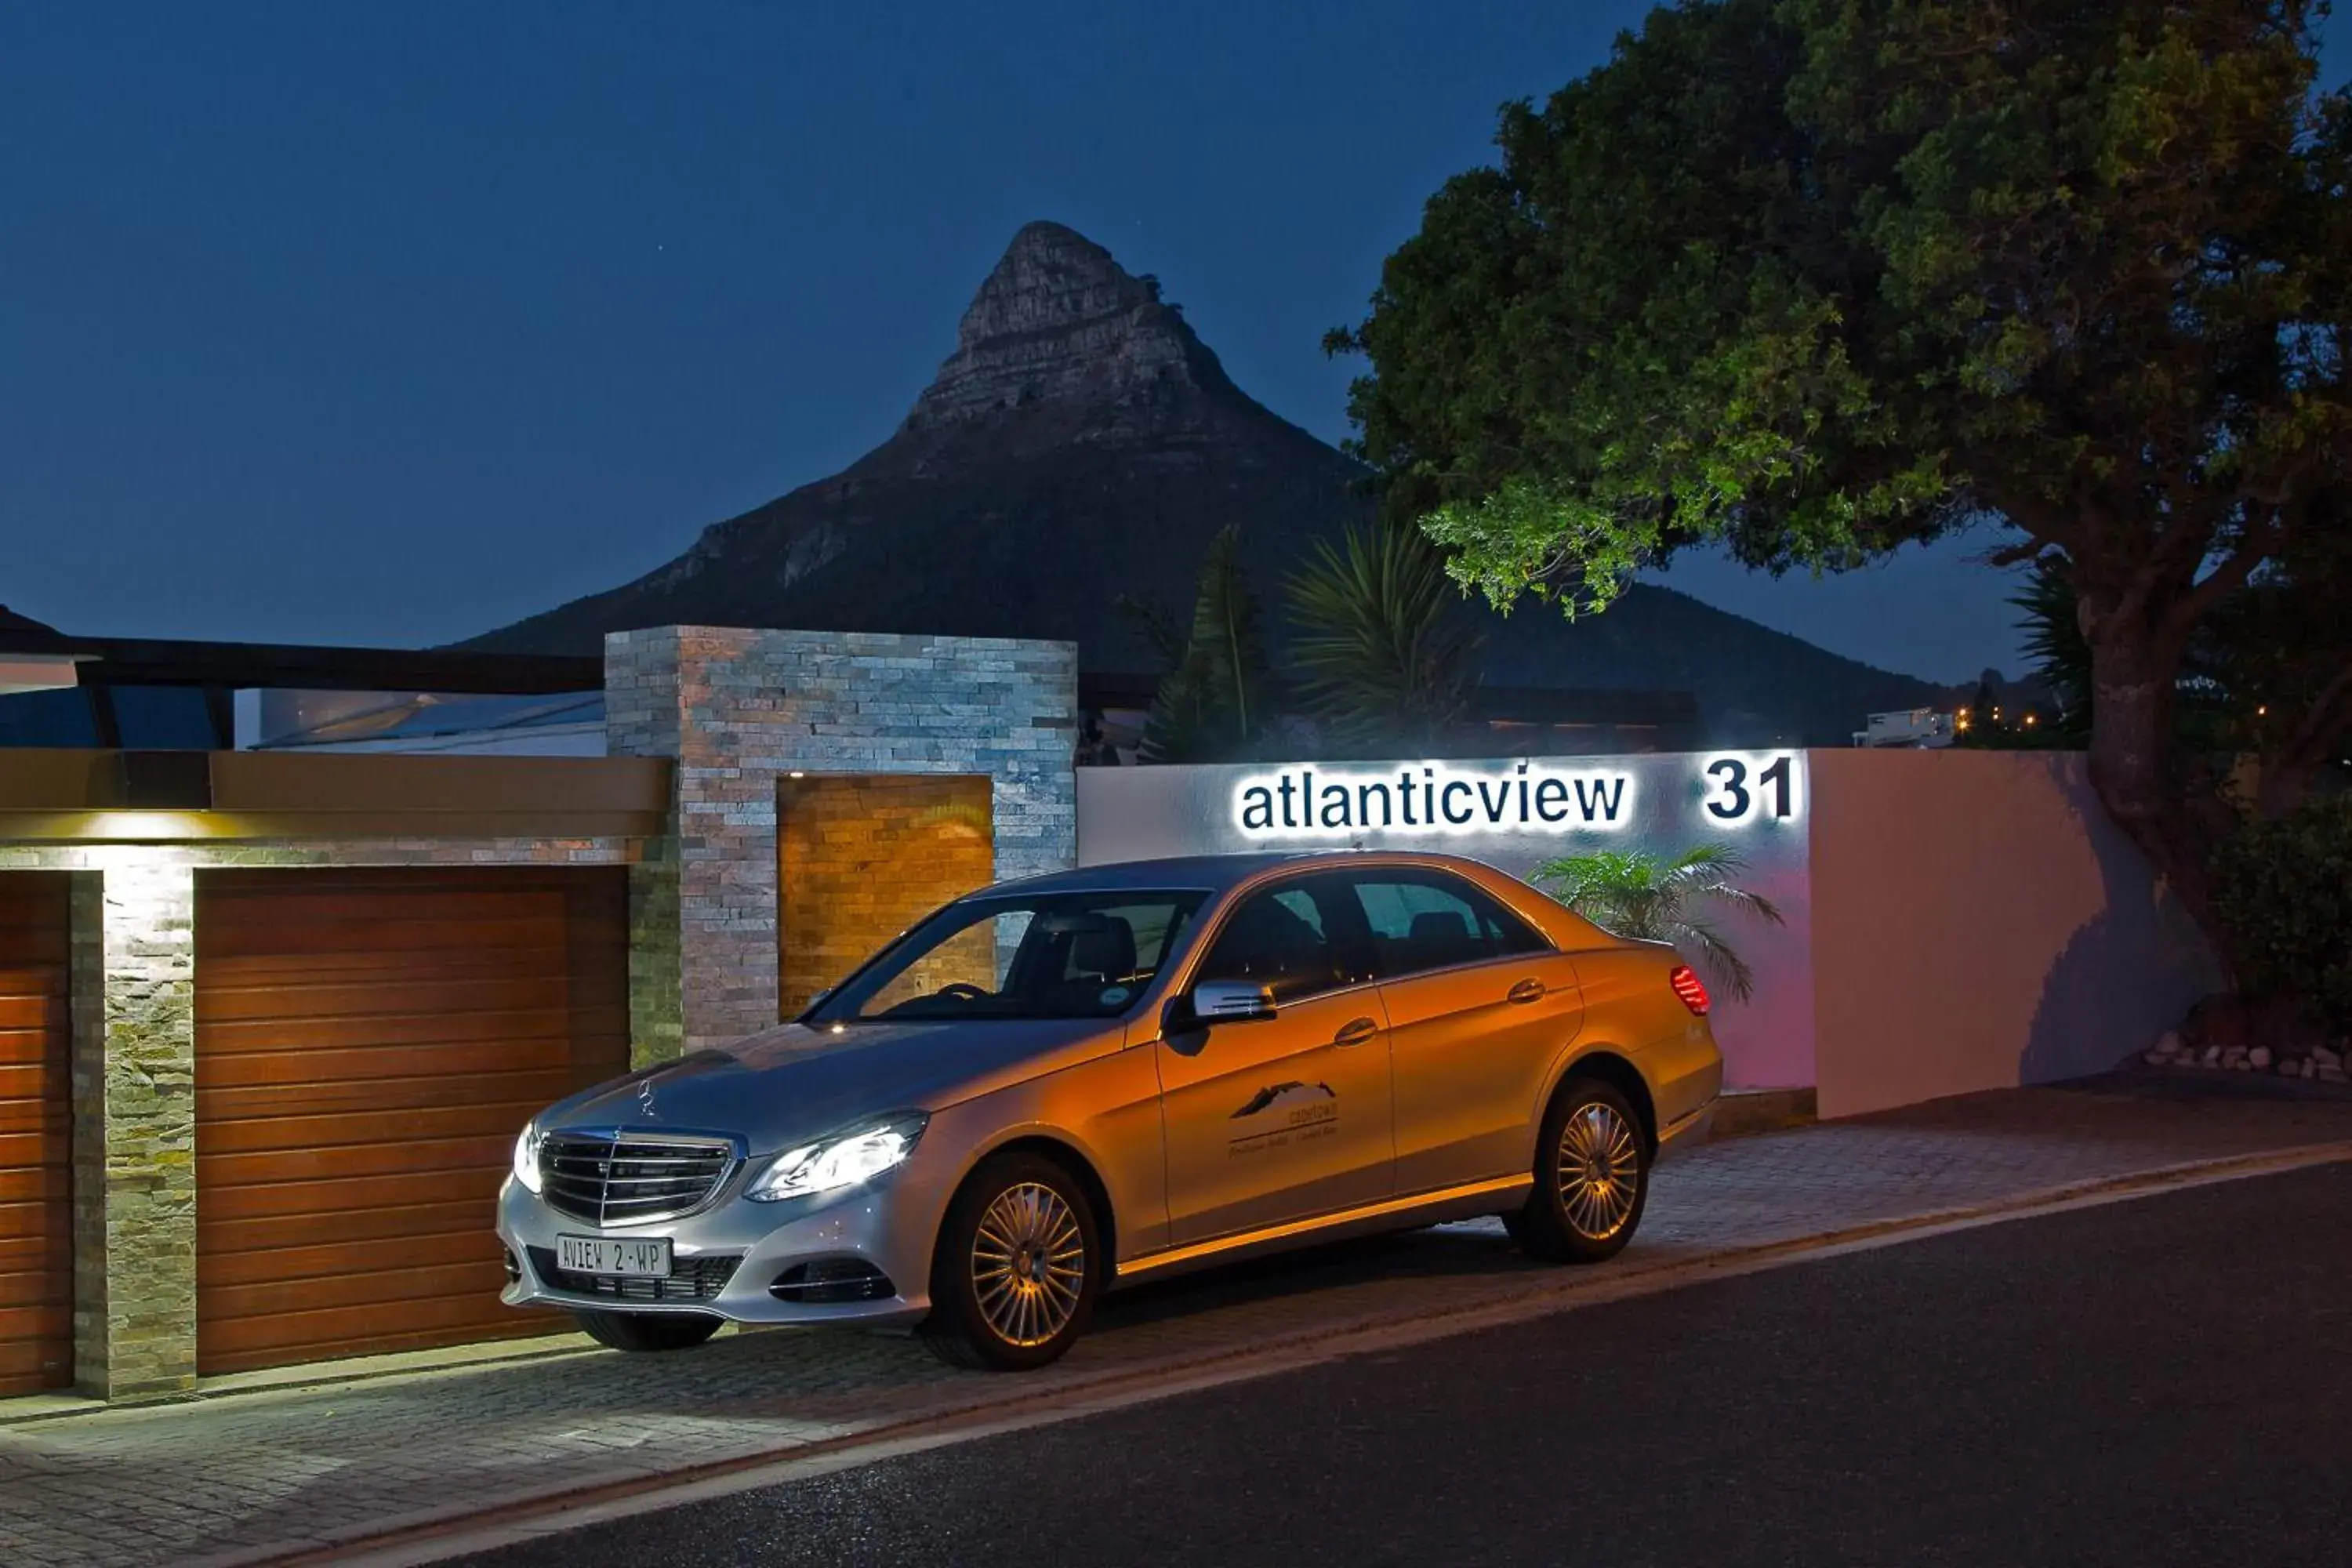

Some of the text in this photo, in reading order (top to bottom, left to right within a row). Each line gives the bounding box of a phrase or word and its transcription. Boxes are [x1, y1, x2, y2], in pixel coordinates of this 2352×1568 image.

[1242, 764, 1625, 829] atlanticview
[1706, 755, 1793, 819] 31
[563, 1240, 603, 1270] AVIEW
